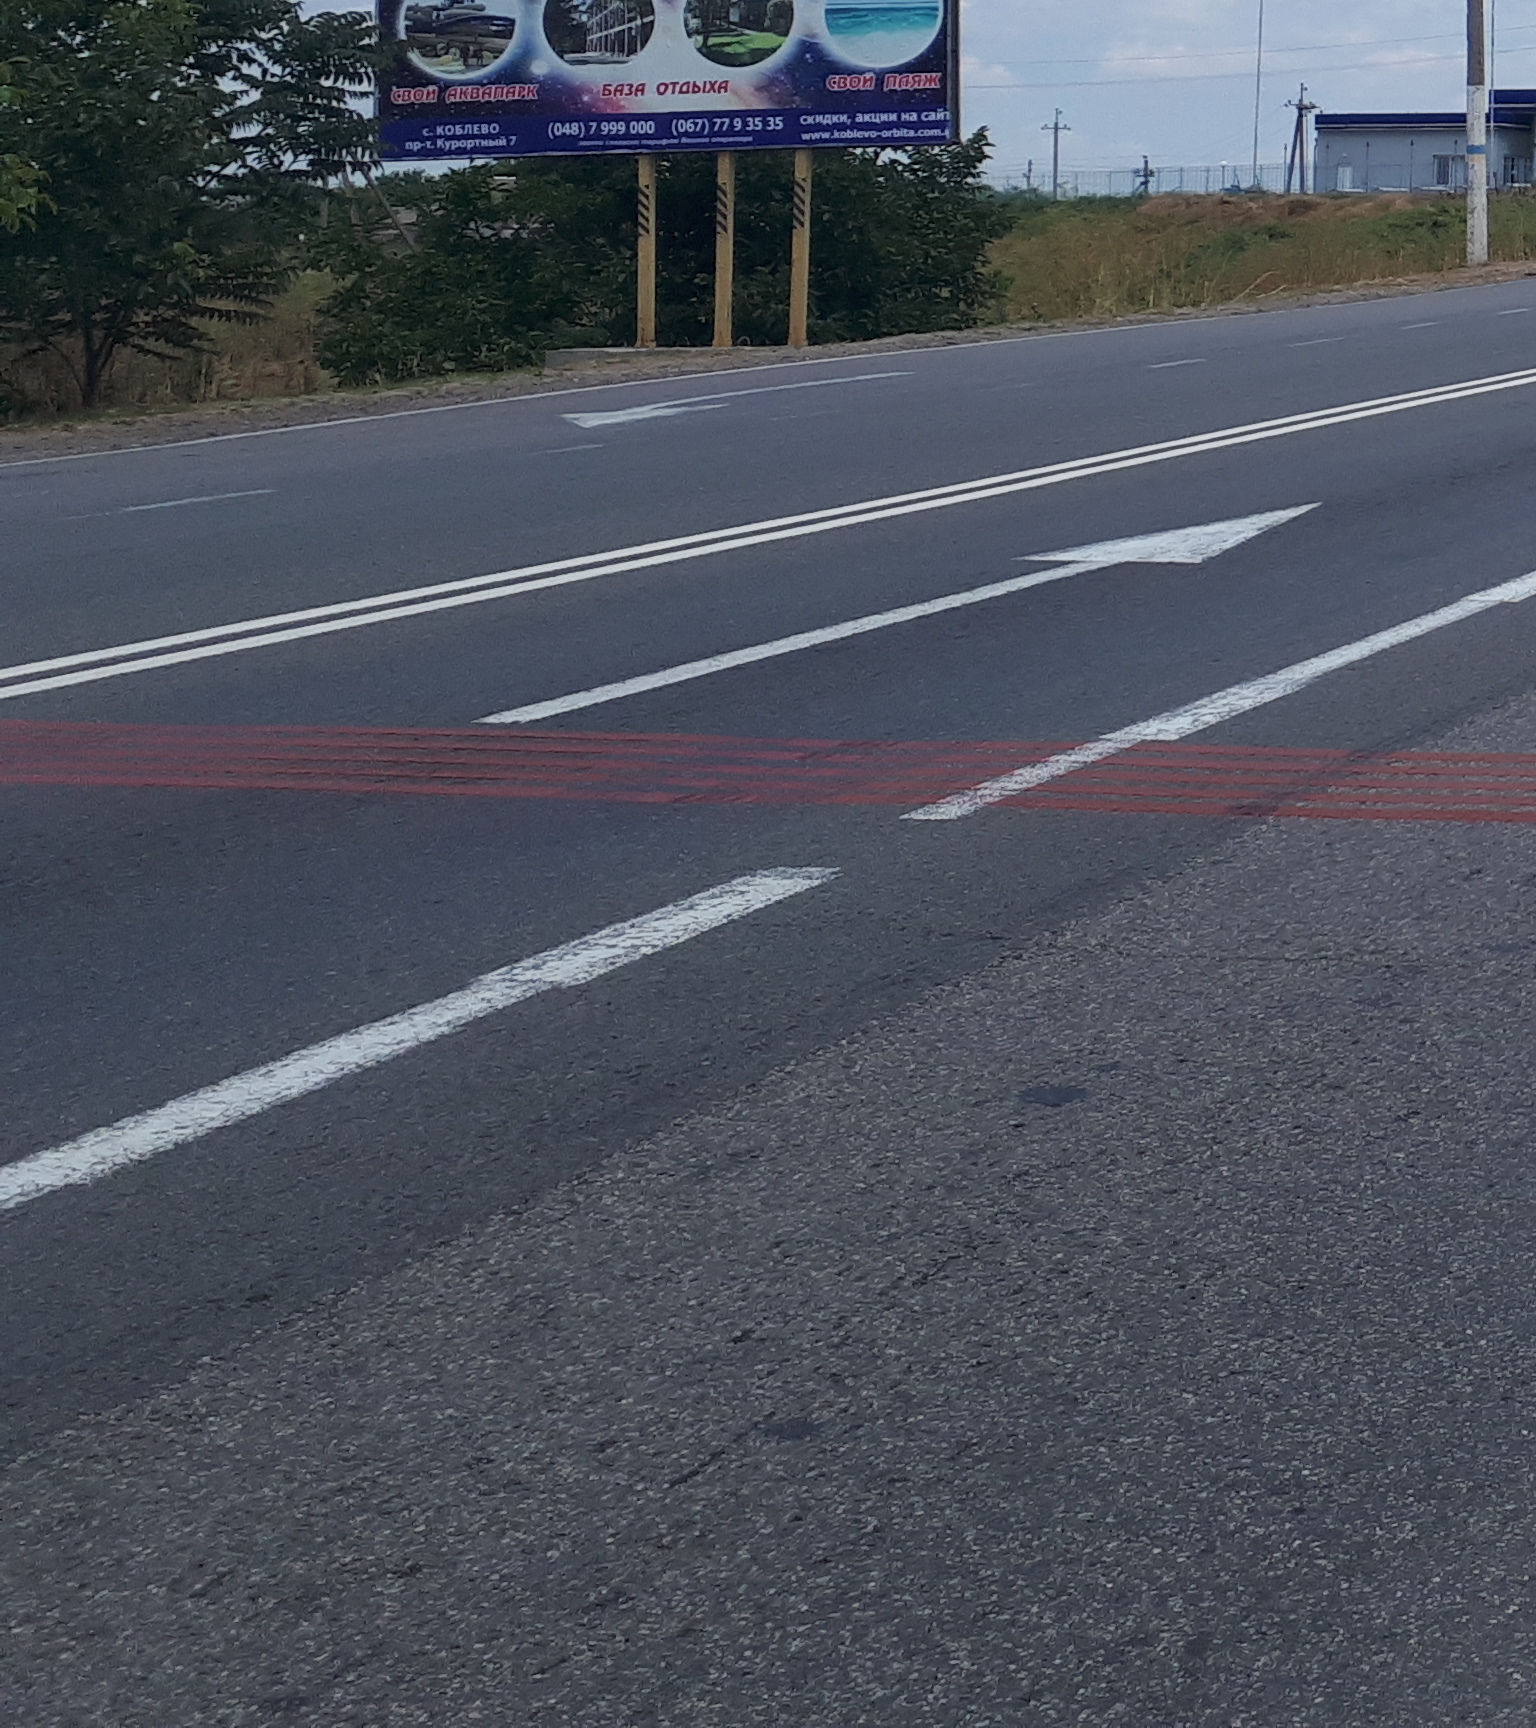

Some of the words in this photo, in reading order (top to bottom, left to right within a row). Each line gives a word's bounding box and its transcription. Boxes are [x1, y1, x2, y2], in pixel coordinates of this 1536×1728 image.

[445, 84, 539, 103] АКВАПАРК
[601, 83, 647, 97] БАЗА
[656, 79, 730, 96] ОТДЫХА
[900, 111, 918, 122] на
[436, 123, 500, 136] КОБЛЕВО
[548, 122, 585, 139] (048)
[589, 122, 598, 135] 7
[600, 121, 625, 135] 999
[629, 121, 656, 134] 000
[671, 119, 710, 135] (067)
[712, 118, 730, 131] 77
[732, 118, 743, 131] 9
[745, 117, 763, 130] 35
[765, 117, 784, 130] 35
